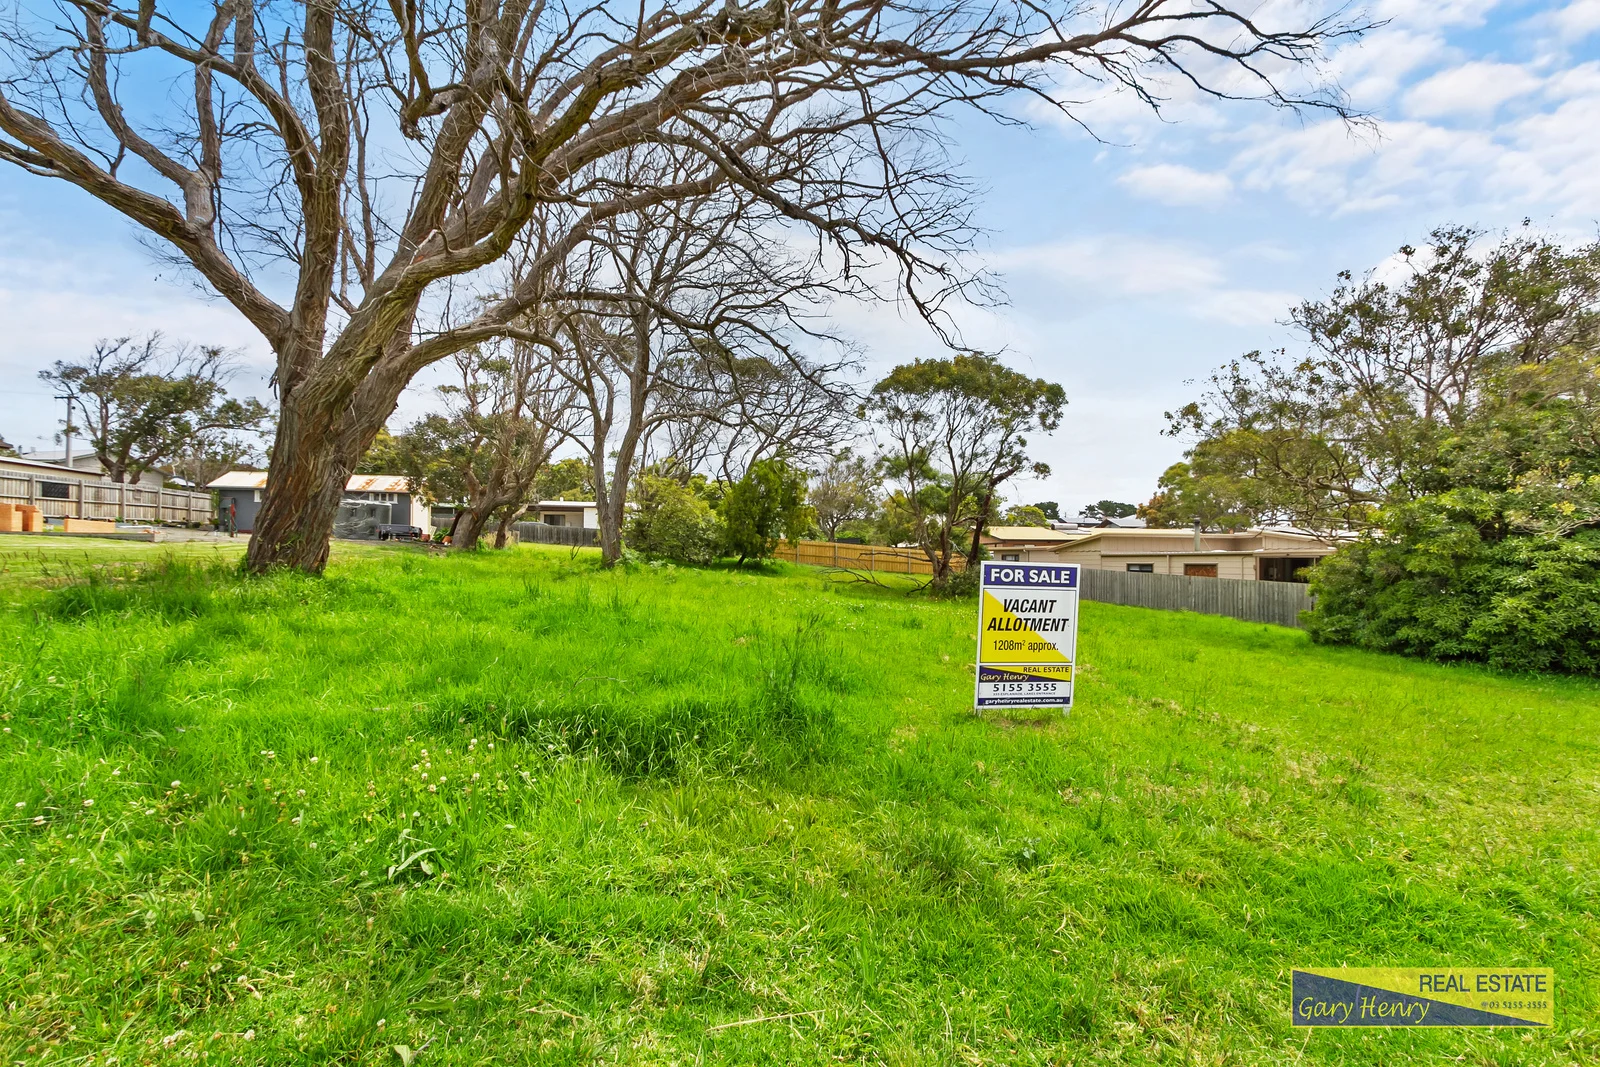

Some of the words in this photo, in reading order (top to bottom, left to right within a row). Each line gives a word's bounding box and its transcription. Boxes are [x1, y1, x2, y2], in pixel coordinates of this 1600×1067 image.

[990, 568, 1025, 583] FOR
[1029, 569, 1071, 584] SALE
[1003, 598, 1057, 613] VACANT
[987, 617, 1069, 632] ALLOTMENT
[1027, 641, 1059, 653] approx.
[980, 673, 1001, 683] Gary
[1003, 672, 1030, 682] Henry
[993, 683, 1023, 692] 5155
[1027, 683, 1057, 692] 3555
[984, 697, 1064, 705] garyhenryrealestate.com.au
